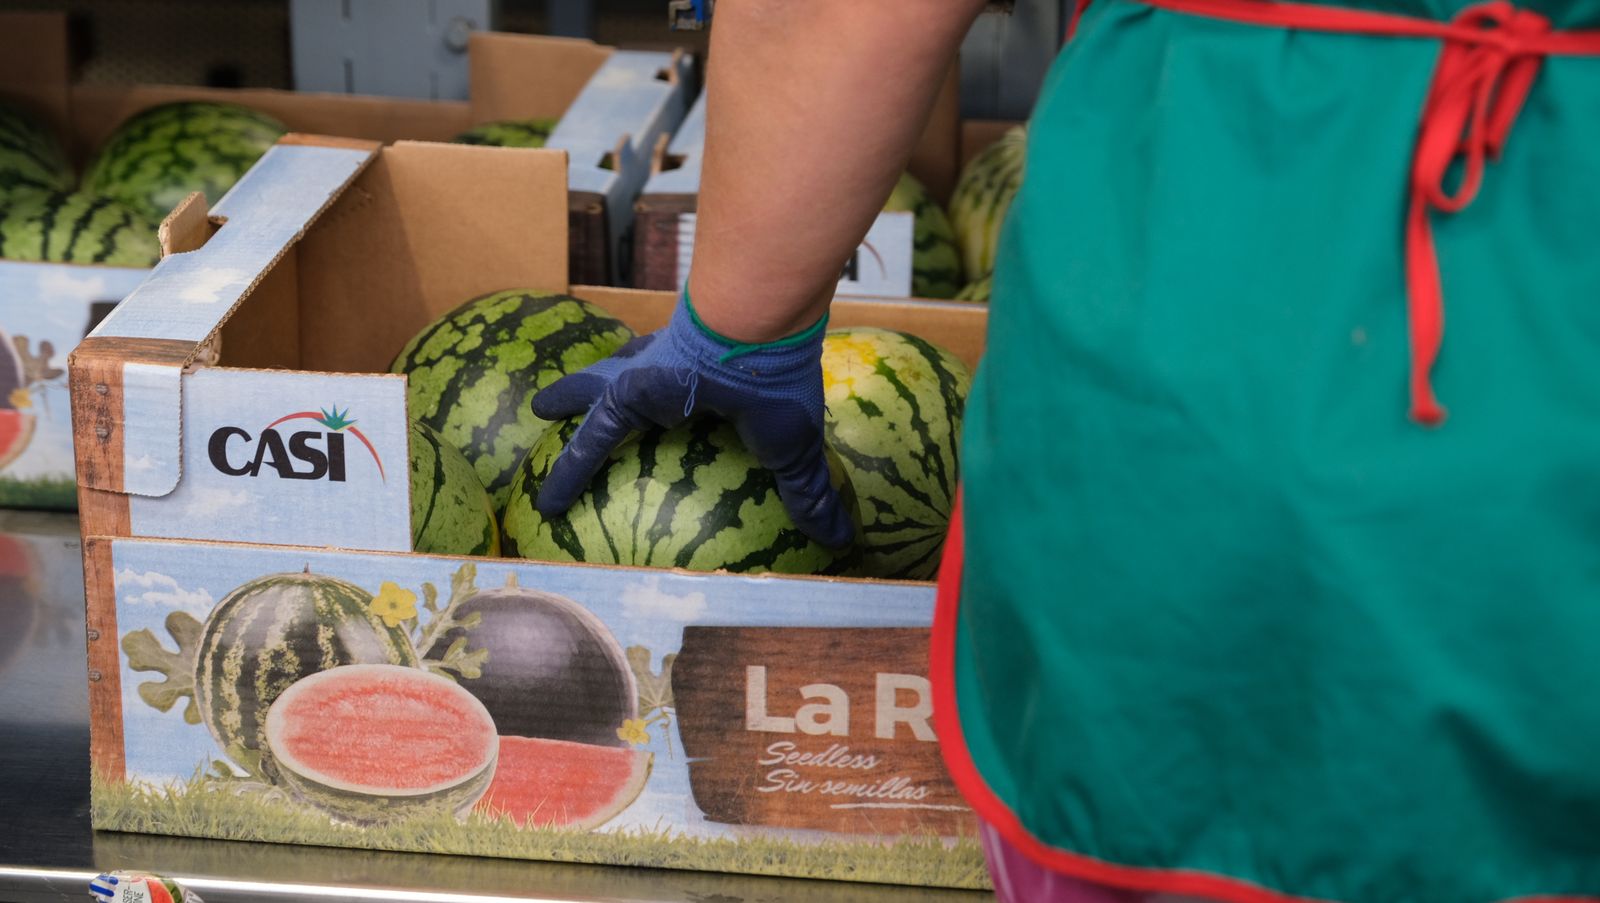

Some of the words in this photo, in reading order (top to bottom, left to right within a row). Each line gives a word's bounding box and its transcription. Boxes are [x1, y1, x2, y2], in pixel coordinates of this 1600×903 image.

[208, 426, 346, 482] CASI
[746, 665, 849, 736] La
[758, 741, 880, 770] Seedless
[757, 768, 818, 793] Sin
[819, 776, 930, 801] semillas
